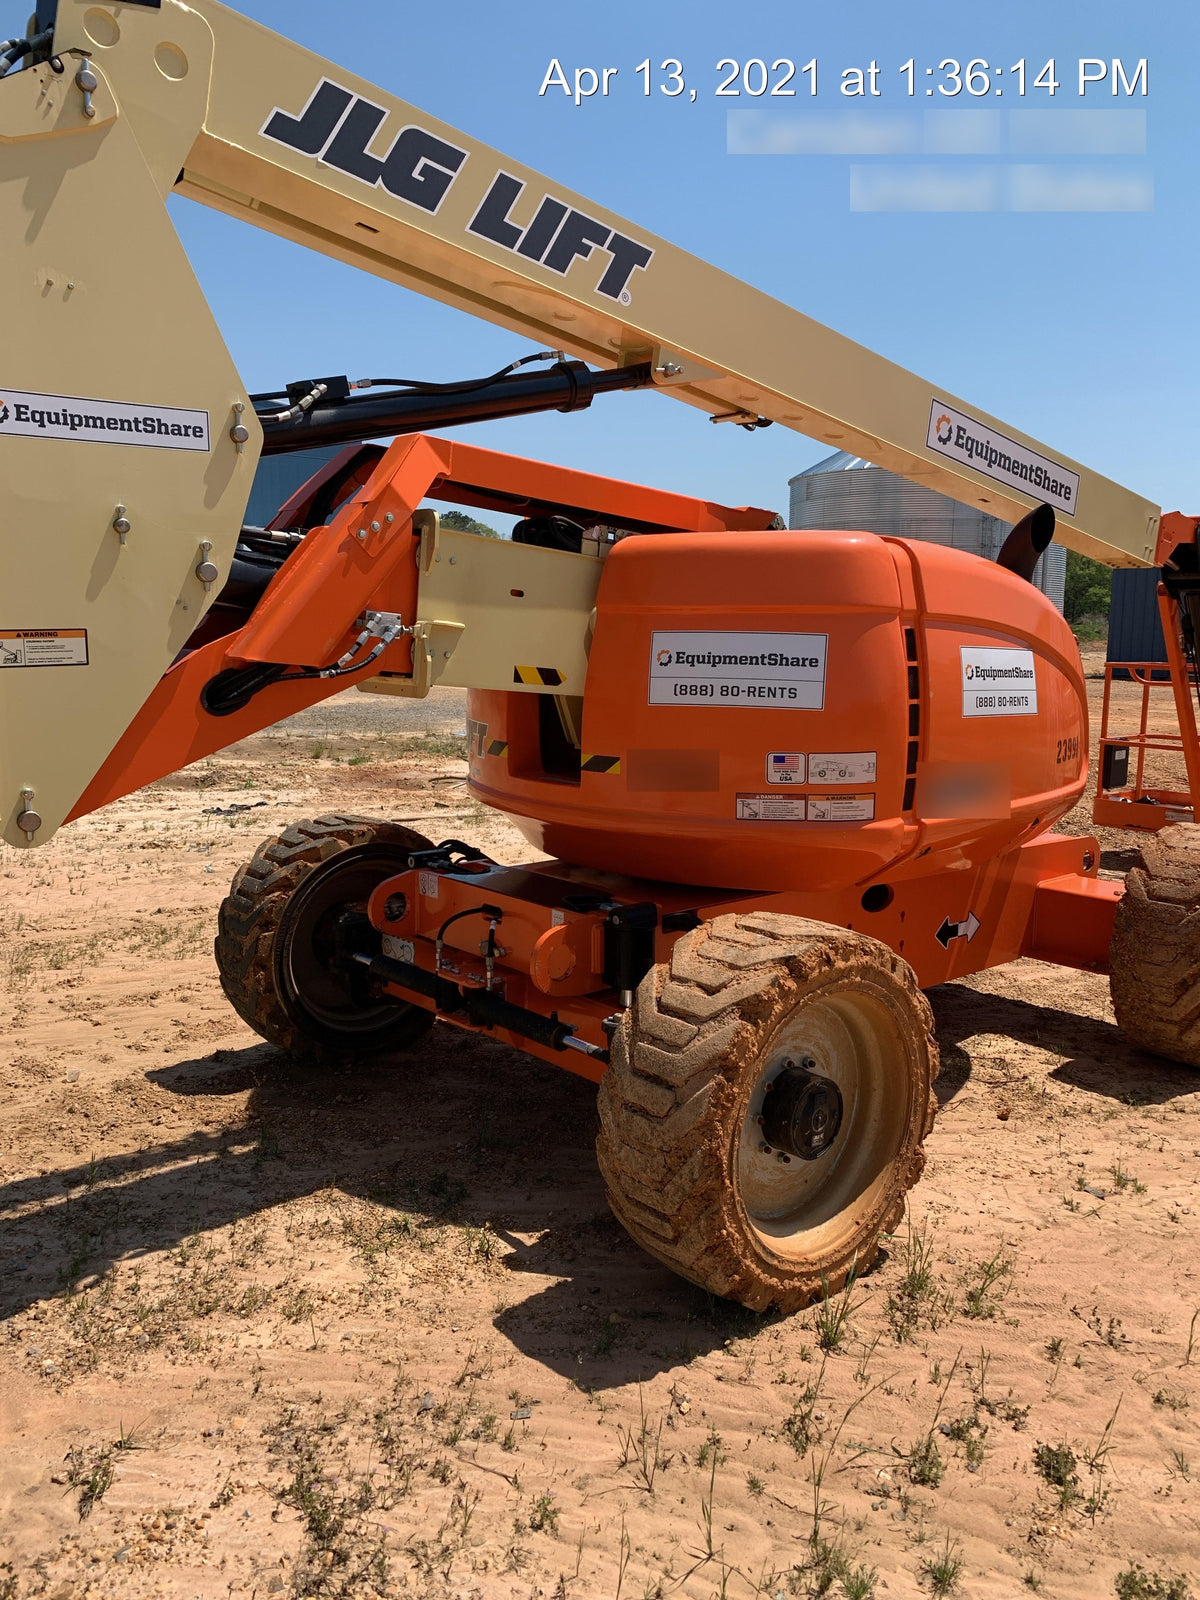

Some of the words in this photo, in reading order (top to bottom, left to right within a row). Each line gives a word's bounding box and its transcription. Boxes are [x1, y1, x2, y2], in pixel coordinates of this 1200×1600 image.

[258, 76, 471, 216] JLG
[464, 169, 656, 302] LIFT
[13, 403, 204, 439] EquipmentShare
[953, 424, 1073, 502] EquipmentShare
[674, 651, 820, 668] EquipmentShare
[974, 665, 1034, 681] EquipmentShare
[673, 683, 714, 697] (888)
[719, 685, 798, 699] 80-RENTS
[975, 696, 996, 708] (888)
[997, 696, 1029, 707] 80-RENTS
